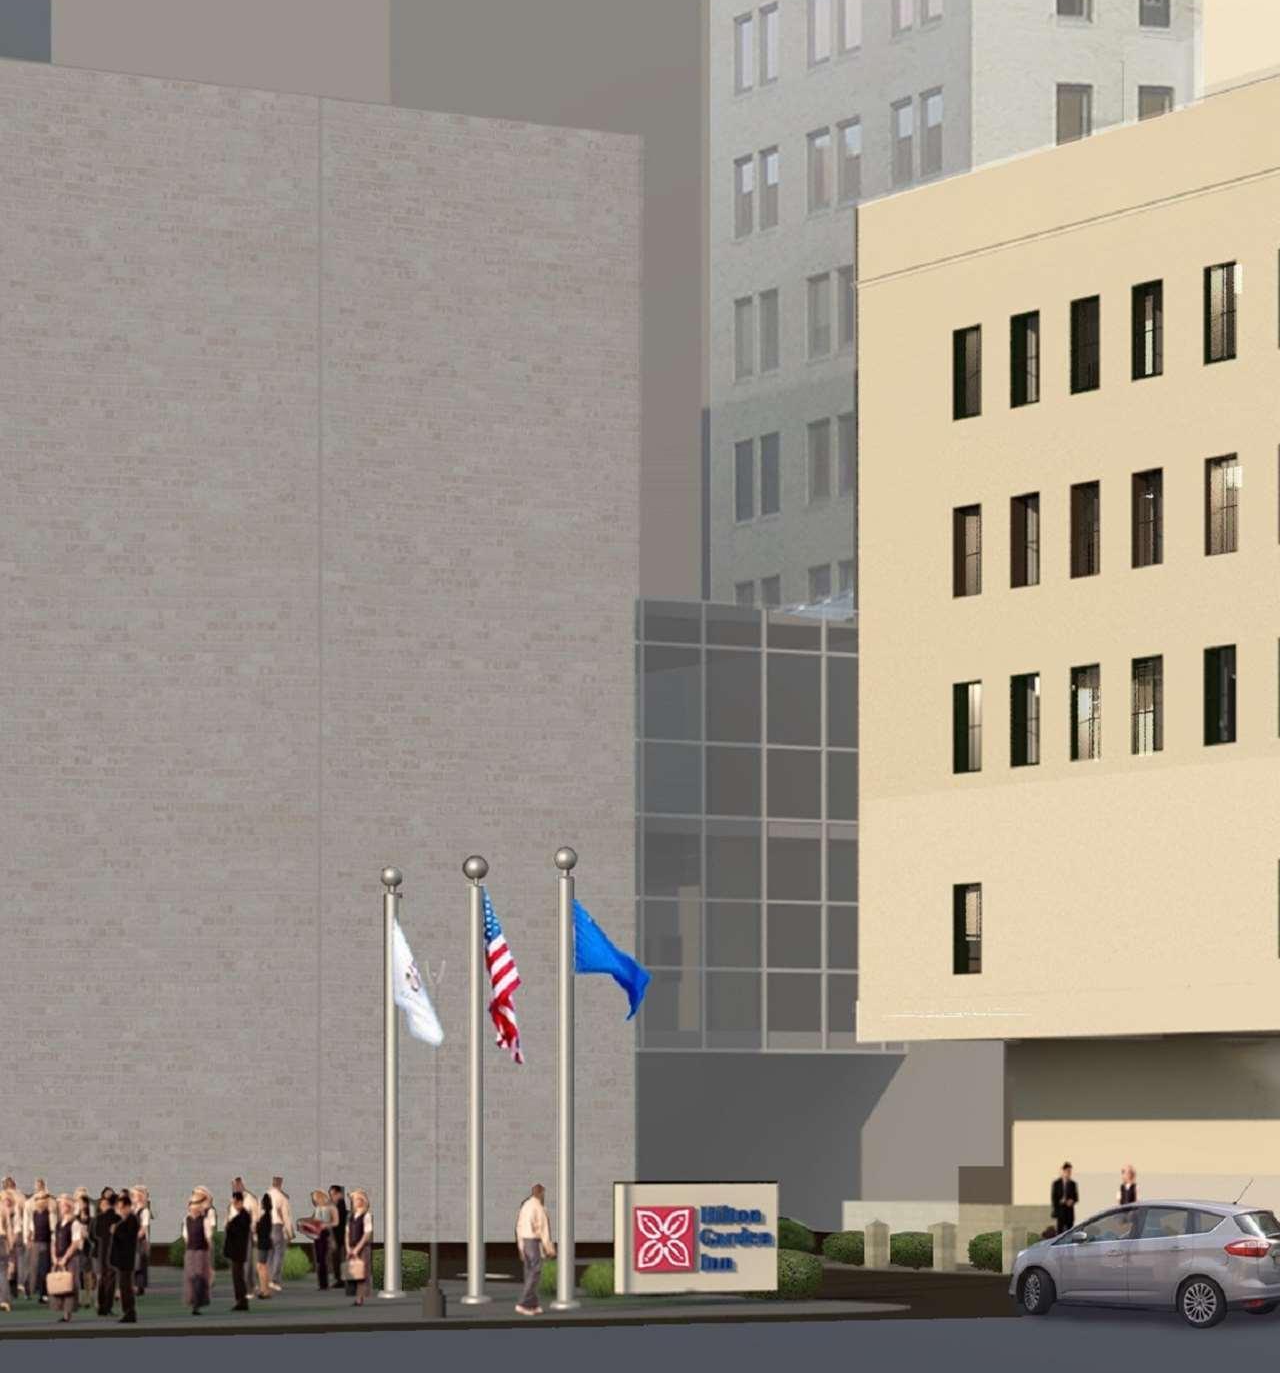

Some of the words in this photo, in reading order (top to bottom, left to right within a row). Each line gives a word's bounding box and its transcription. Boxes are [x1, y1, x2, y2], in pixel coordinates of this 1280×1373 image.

[700, 1204, 764, 1225] Hilton
[699, 1227, 775, 1248] Garden
[700, 1253, 738, 1273] Inn
